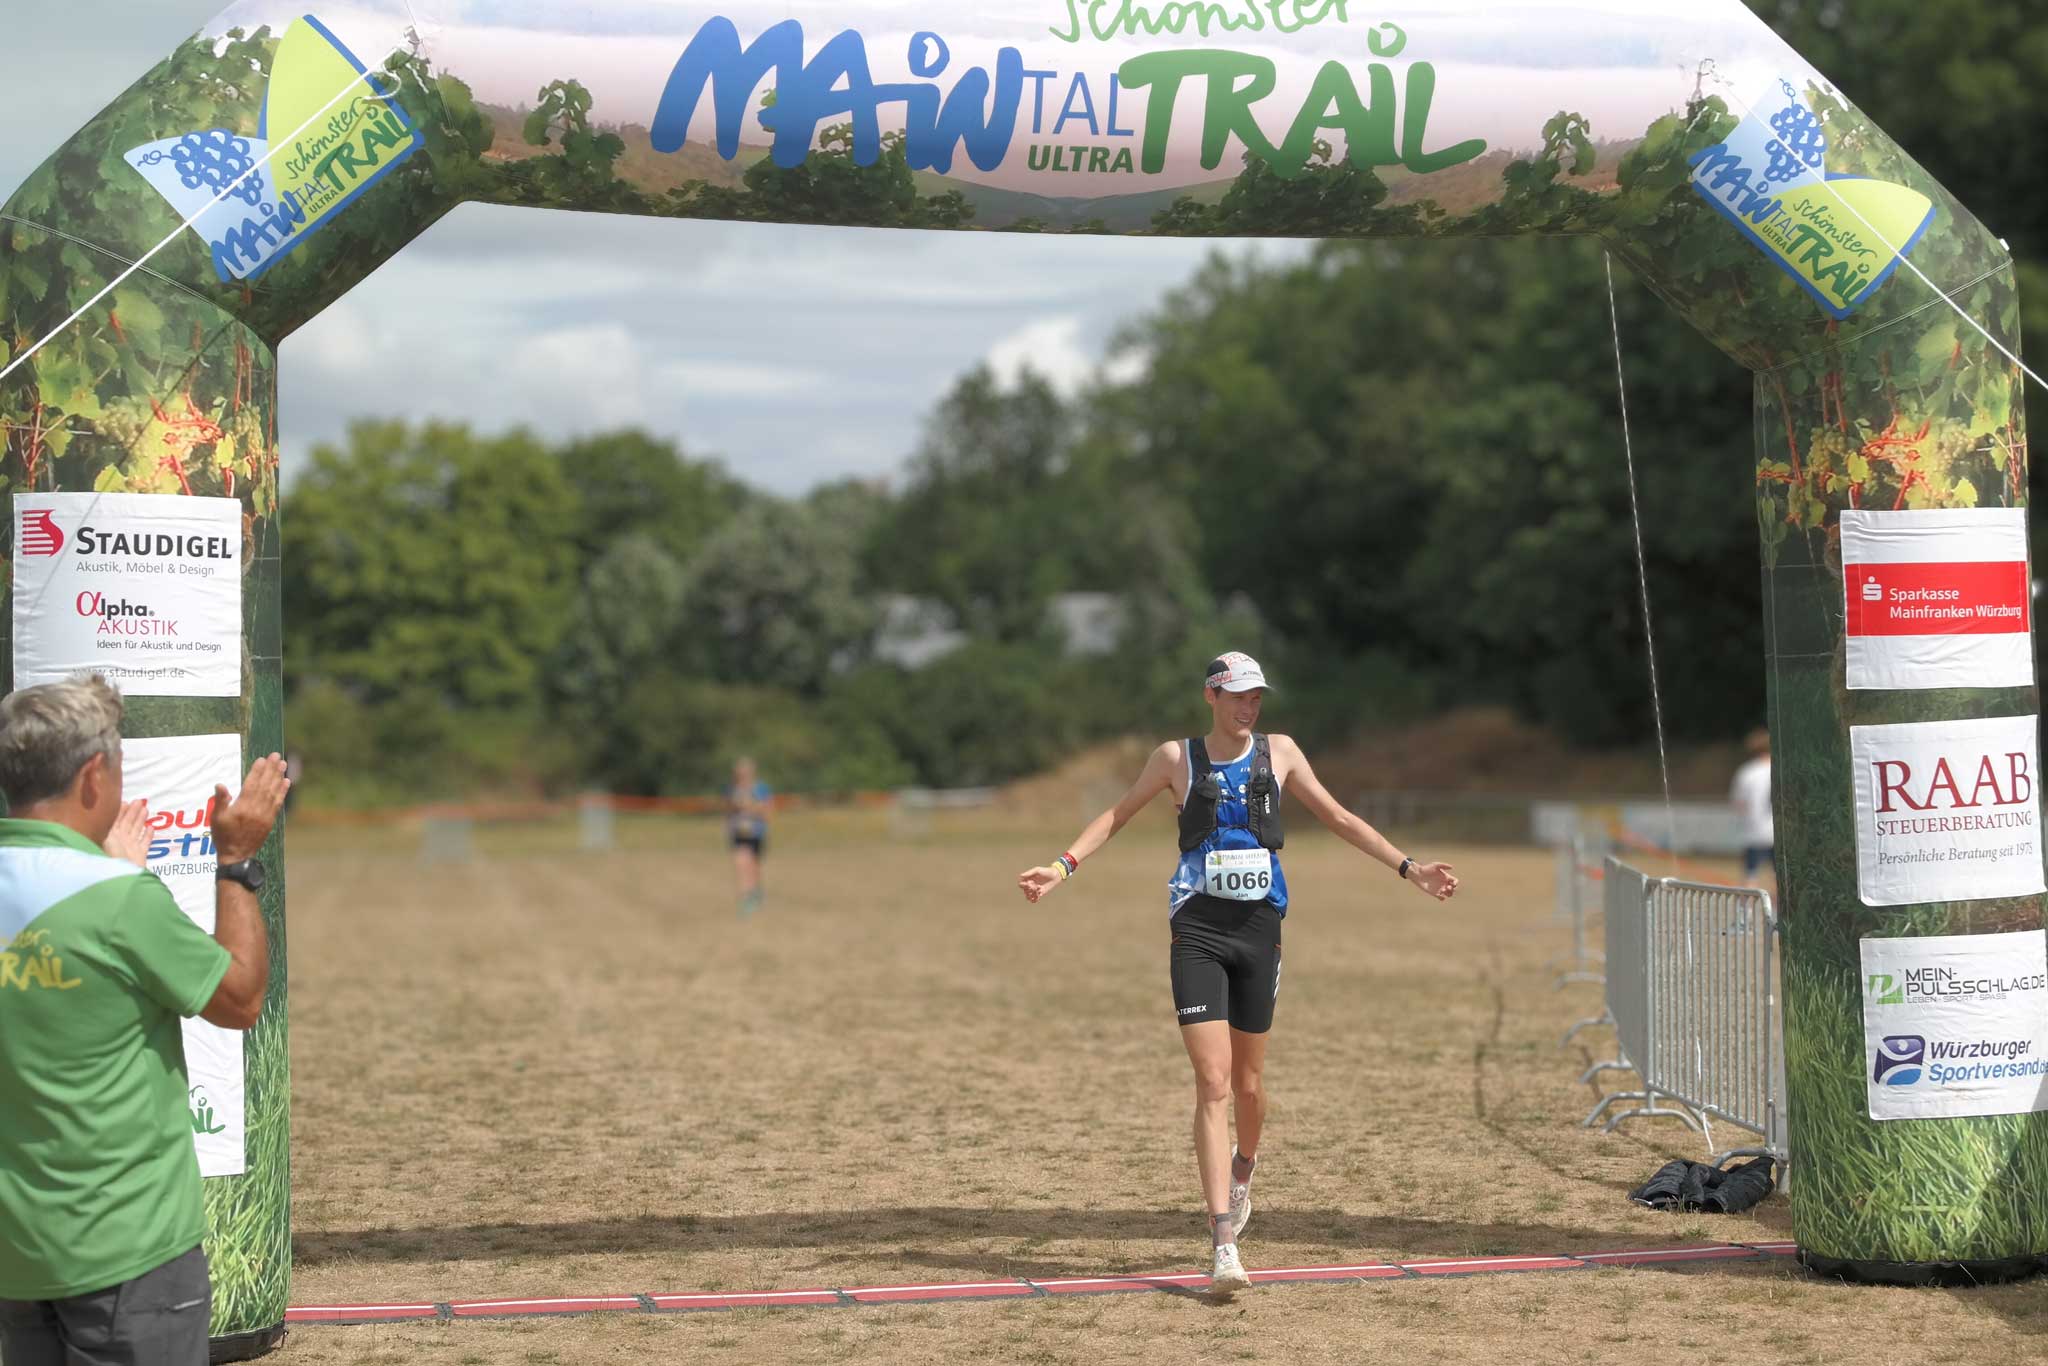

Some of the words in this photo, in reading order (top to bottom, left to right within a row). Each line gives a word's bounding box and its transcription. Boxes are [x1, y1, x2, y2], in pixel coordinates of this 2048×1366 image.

[1027, 145, 1135, 174] ULTRA
[308, 189, 339, 215] ULTRA
[1761, 224, 1788, 250] ULTRA
[75, 527, 232, 559] STAUDIGEL
[76, 561, 122, 574] Akustik,
[126, 562, 164, 574] Möbel
[167, 564, 176, 574] &
[179, 563, 215, 578] Design
[1889, 587, 1960, 603] Sparkasse
[1890, 605, 1974, 619] Mainfranken
[1976, 604, 2022, 619] Würzburg
[97, 619, 179, 636] AKUSTIK
[96, 640, 122, 650] Ideen
[124, 640, 137, 650] für
[140, 640, 174, 650] Akustik
[176, 641, 193, 651] und
[195, 642, 222, 653] Design
[1872, 751, 2031, 813] RAAB
[1876, 810, 2032, 836] STEUERBERATUNG
[1879, 848, 1946, 865] Persönliche
[1948, 848, 1997, 863] Beratung
[1999, 844, 2014, 857] seit
[1211, 871, 1269, 891] 1066
[1905, 968, 1958, 982] MEIN-
[1906, 975, 2045, 996] PULSSCHLAG.DE
[1180, 1004, 1207, 1015] TERREX
[1907, 996, 1937, 1004] LEBEN
[1944, 995, 1973, 1003] SPORT
[1930, 1040, 2031, 1060] Würzburger
